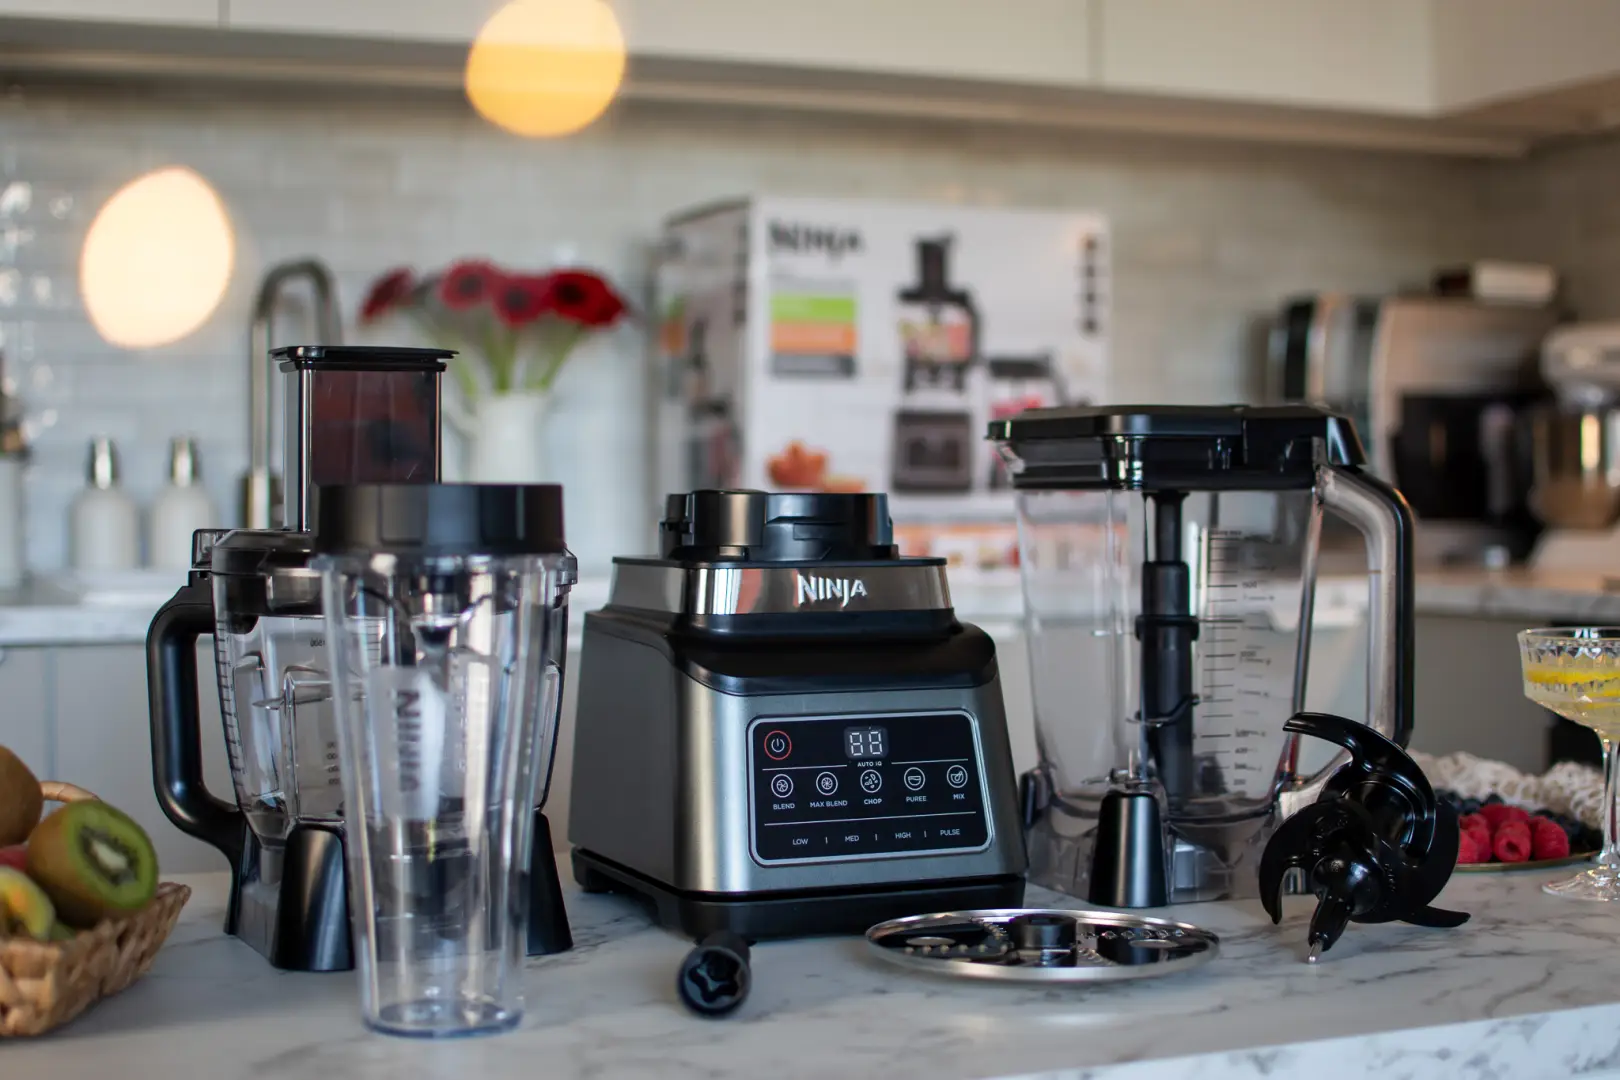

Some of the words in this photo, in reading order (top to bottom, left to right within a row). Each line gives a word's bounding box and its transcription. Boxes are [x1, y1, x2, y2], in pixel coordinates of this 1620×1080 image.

[796, 573, 868, 608] NINJA
[857, 760, 874, 768] AUTO
[826, 799, 848, 807] BLEND
[905, 795, 927, 803] PUREE
[773, 802, 796, 810] BLEND
[894, 831, 912, 839] HIGH
[939, 828, 961, 836] PULSE
[792, 837, 809, 846] LOW
[844, 834, 860, 842] MED
